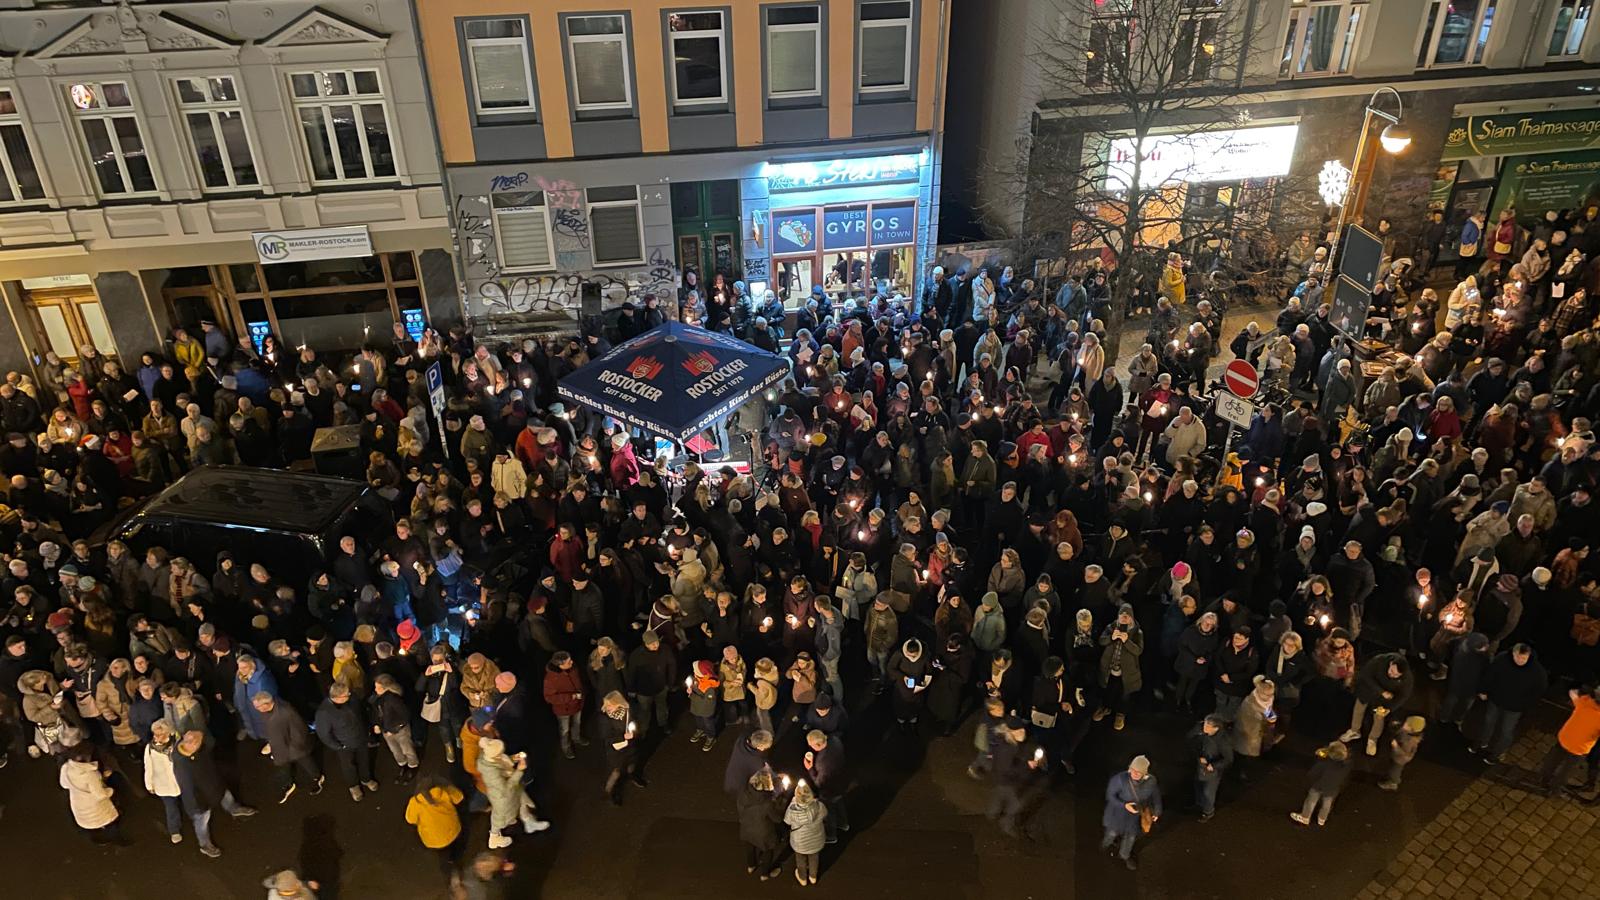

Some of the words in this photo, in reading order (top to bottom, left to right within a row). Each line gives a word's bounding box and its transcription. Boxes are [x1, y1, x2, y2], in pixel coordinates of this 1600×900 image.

[1476, 119, 1516, 140] Siam
[1518, 117, 1600, 137] Thaimassage
[843, 211, 866, 220] BEST
[826, 217, 900, 235] GYROS
[874, 231, 884, 240] IN
[886, 229, 911, 239] TOWN
[289, 237, 367, 248] MAKLER-ROSTOCK.com
[429, 368, 437, 389] P
[597, 369, 663, 402] ROSTOCKER
[685, 358, 749, 399] ROSTOCKER
[602, 386, 620, 397] SEIT
[712, 385, 729, 397] SEIT
[557, 386, 574, 398] Ein
[574, 394, 602, 410] echtes
[603, 404, 627, 419] Kind
[628, 414, 645, 426] der
[681, 425, 697, 440] Ein
[698, 405, 728, 428] echtes
[729, 390, 749, 408] Kind
[750, 383, 764, 395] der
